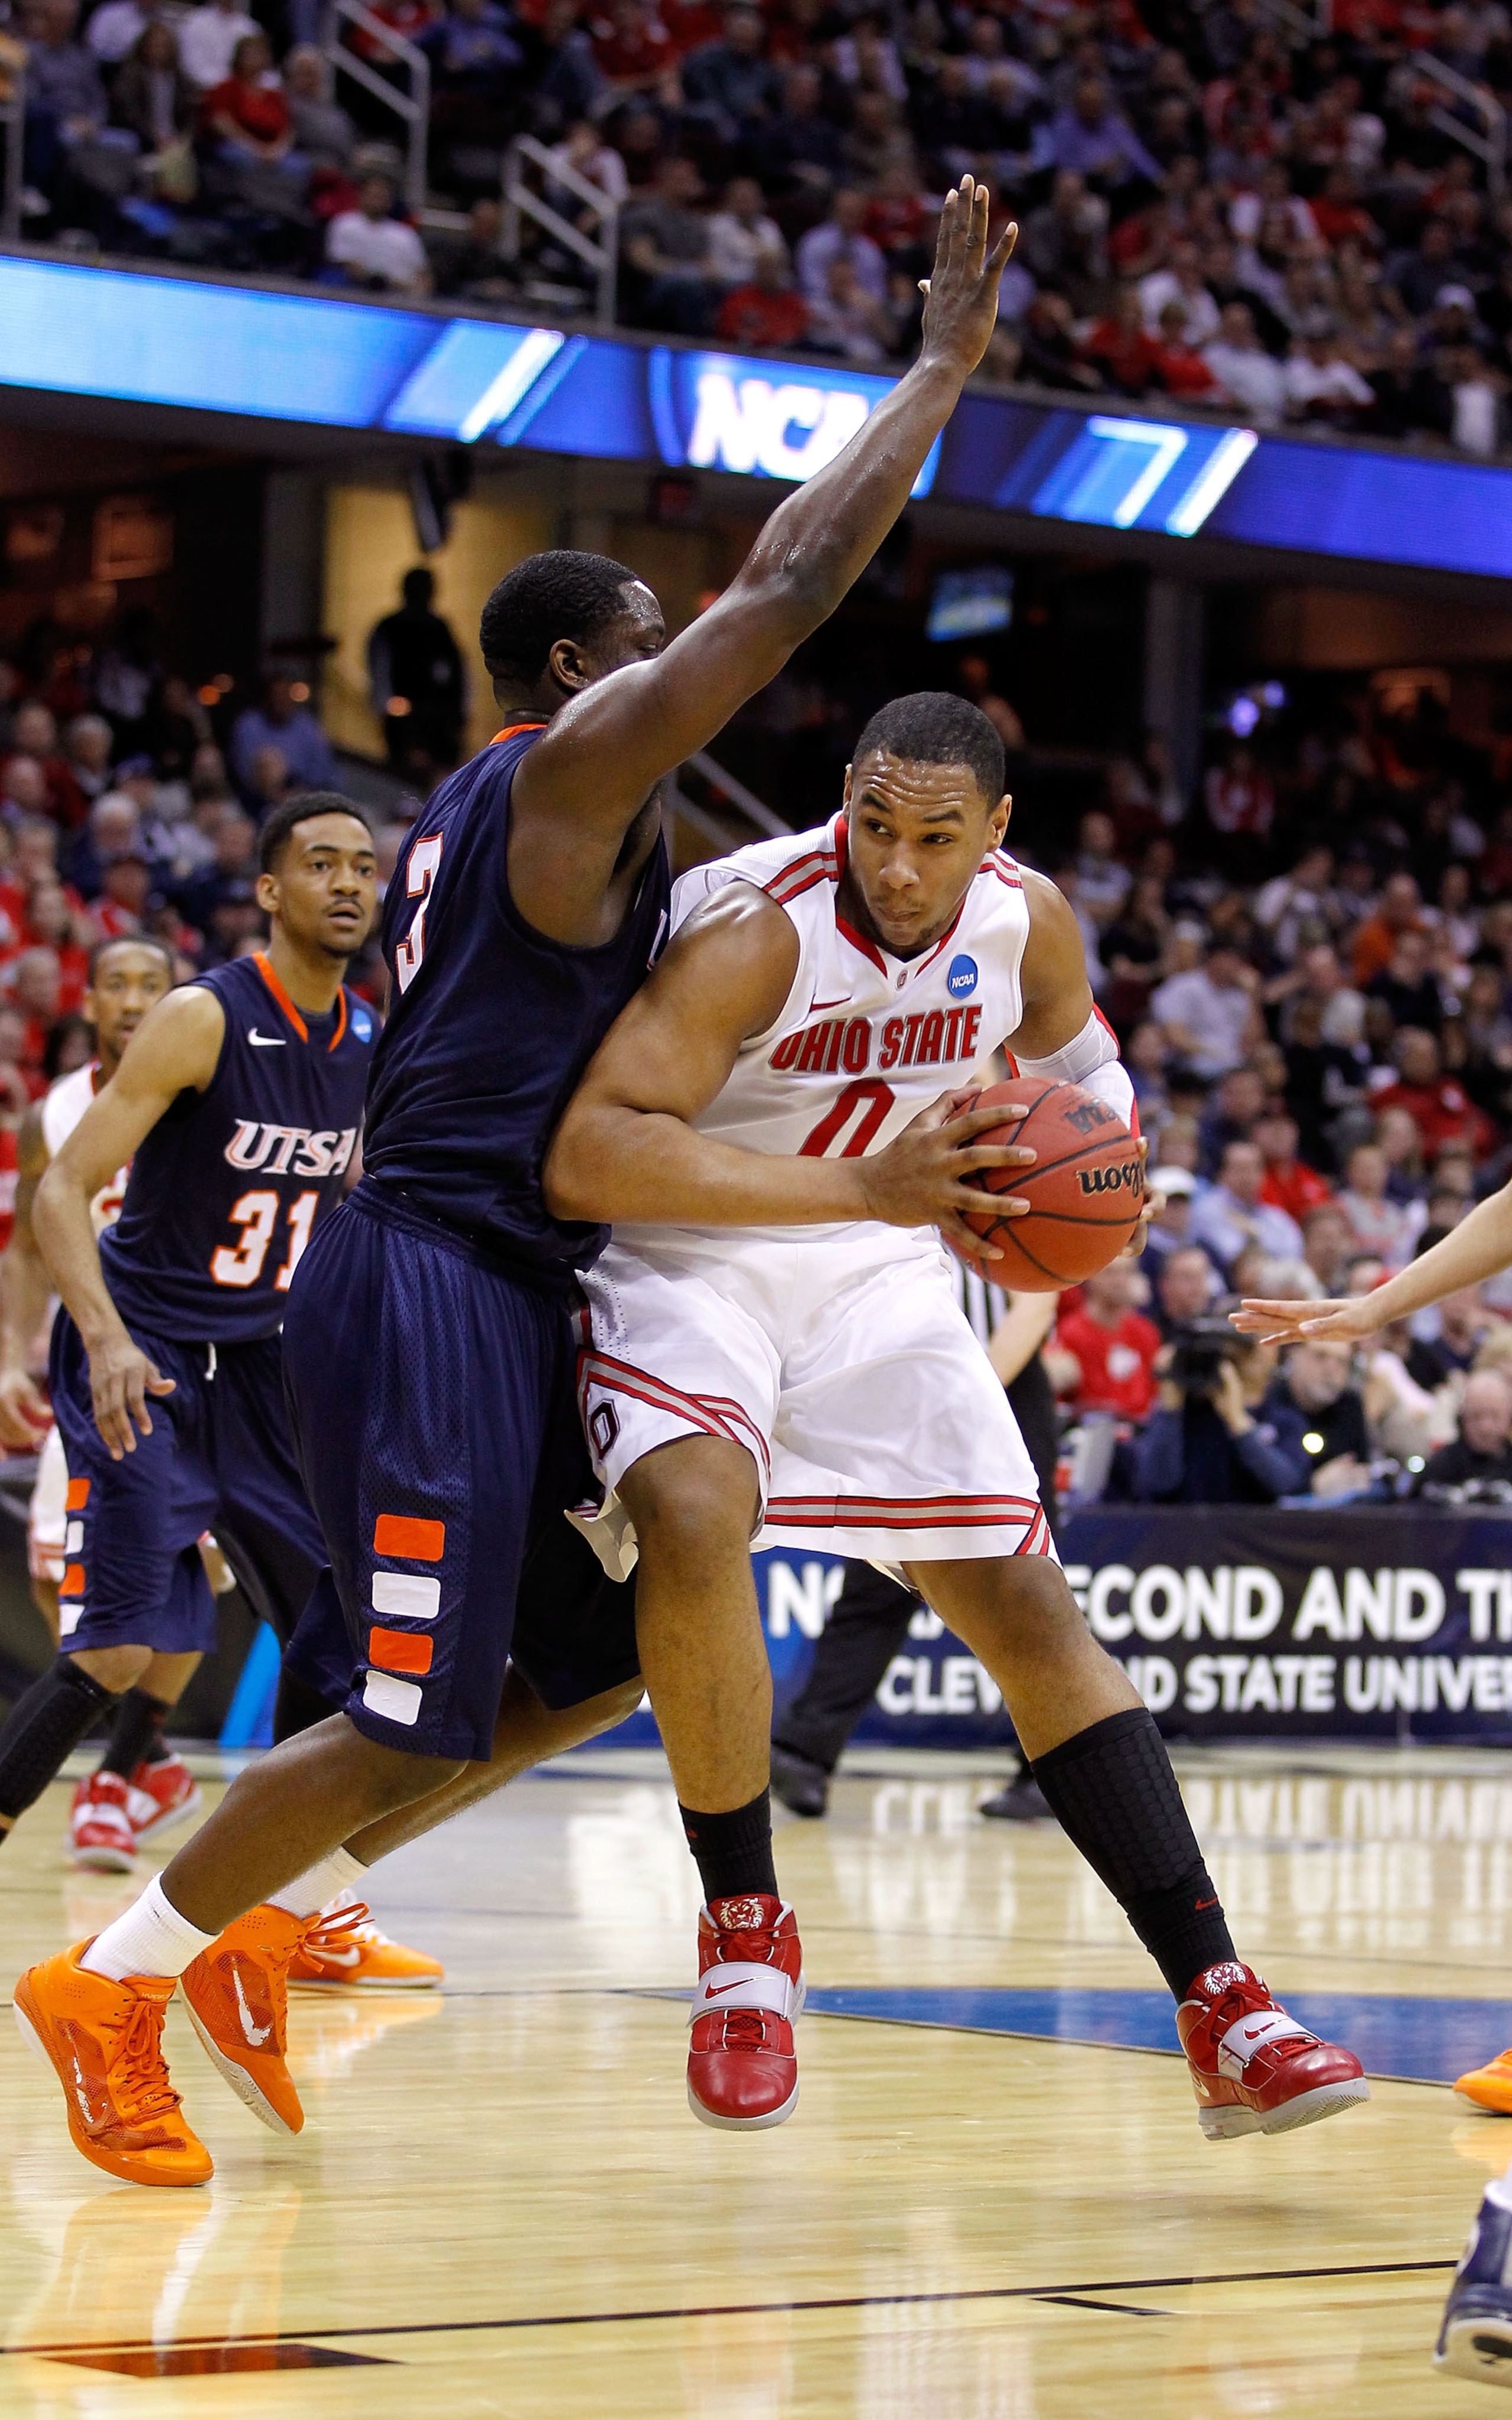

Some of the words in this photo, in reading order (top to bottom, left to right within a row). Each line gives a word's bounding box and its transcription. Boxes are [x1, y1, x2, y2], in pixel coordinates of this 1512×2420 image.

[687, 373, 881, 483] NCA
[951, 973, 975, 989] NCAA
[768, 1016, 874, 1075] OHIO
[877, 1004, 983, 1070] STATE
[224, 1118, 357, 1177] UTSA
[209, 1189, 320, 1292] 31
[1292, 1566, 1446, 1642] AND
[1184, 1654, 1337, 1713] STATE
[1344, 1654, 1512, 1713] UNIVE
